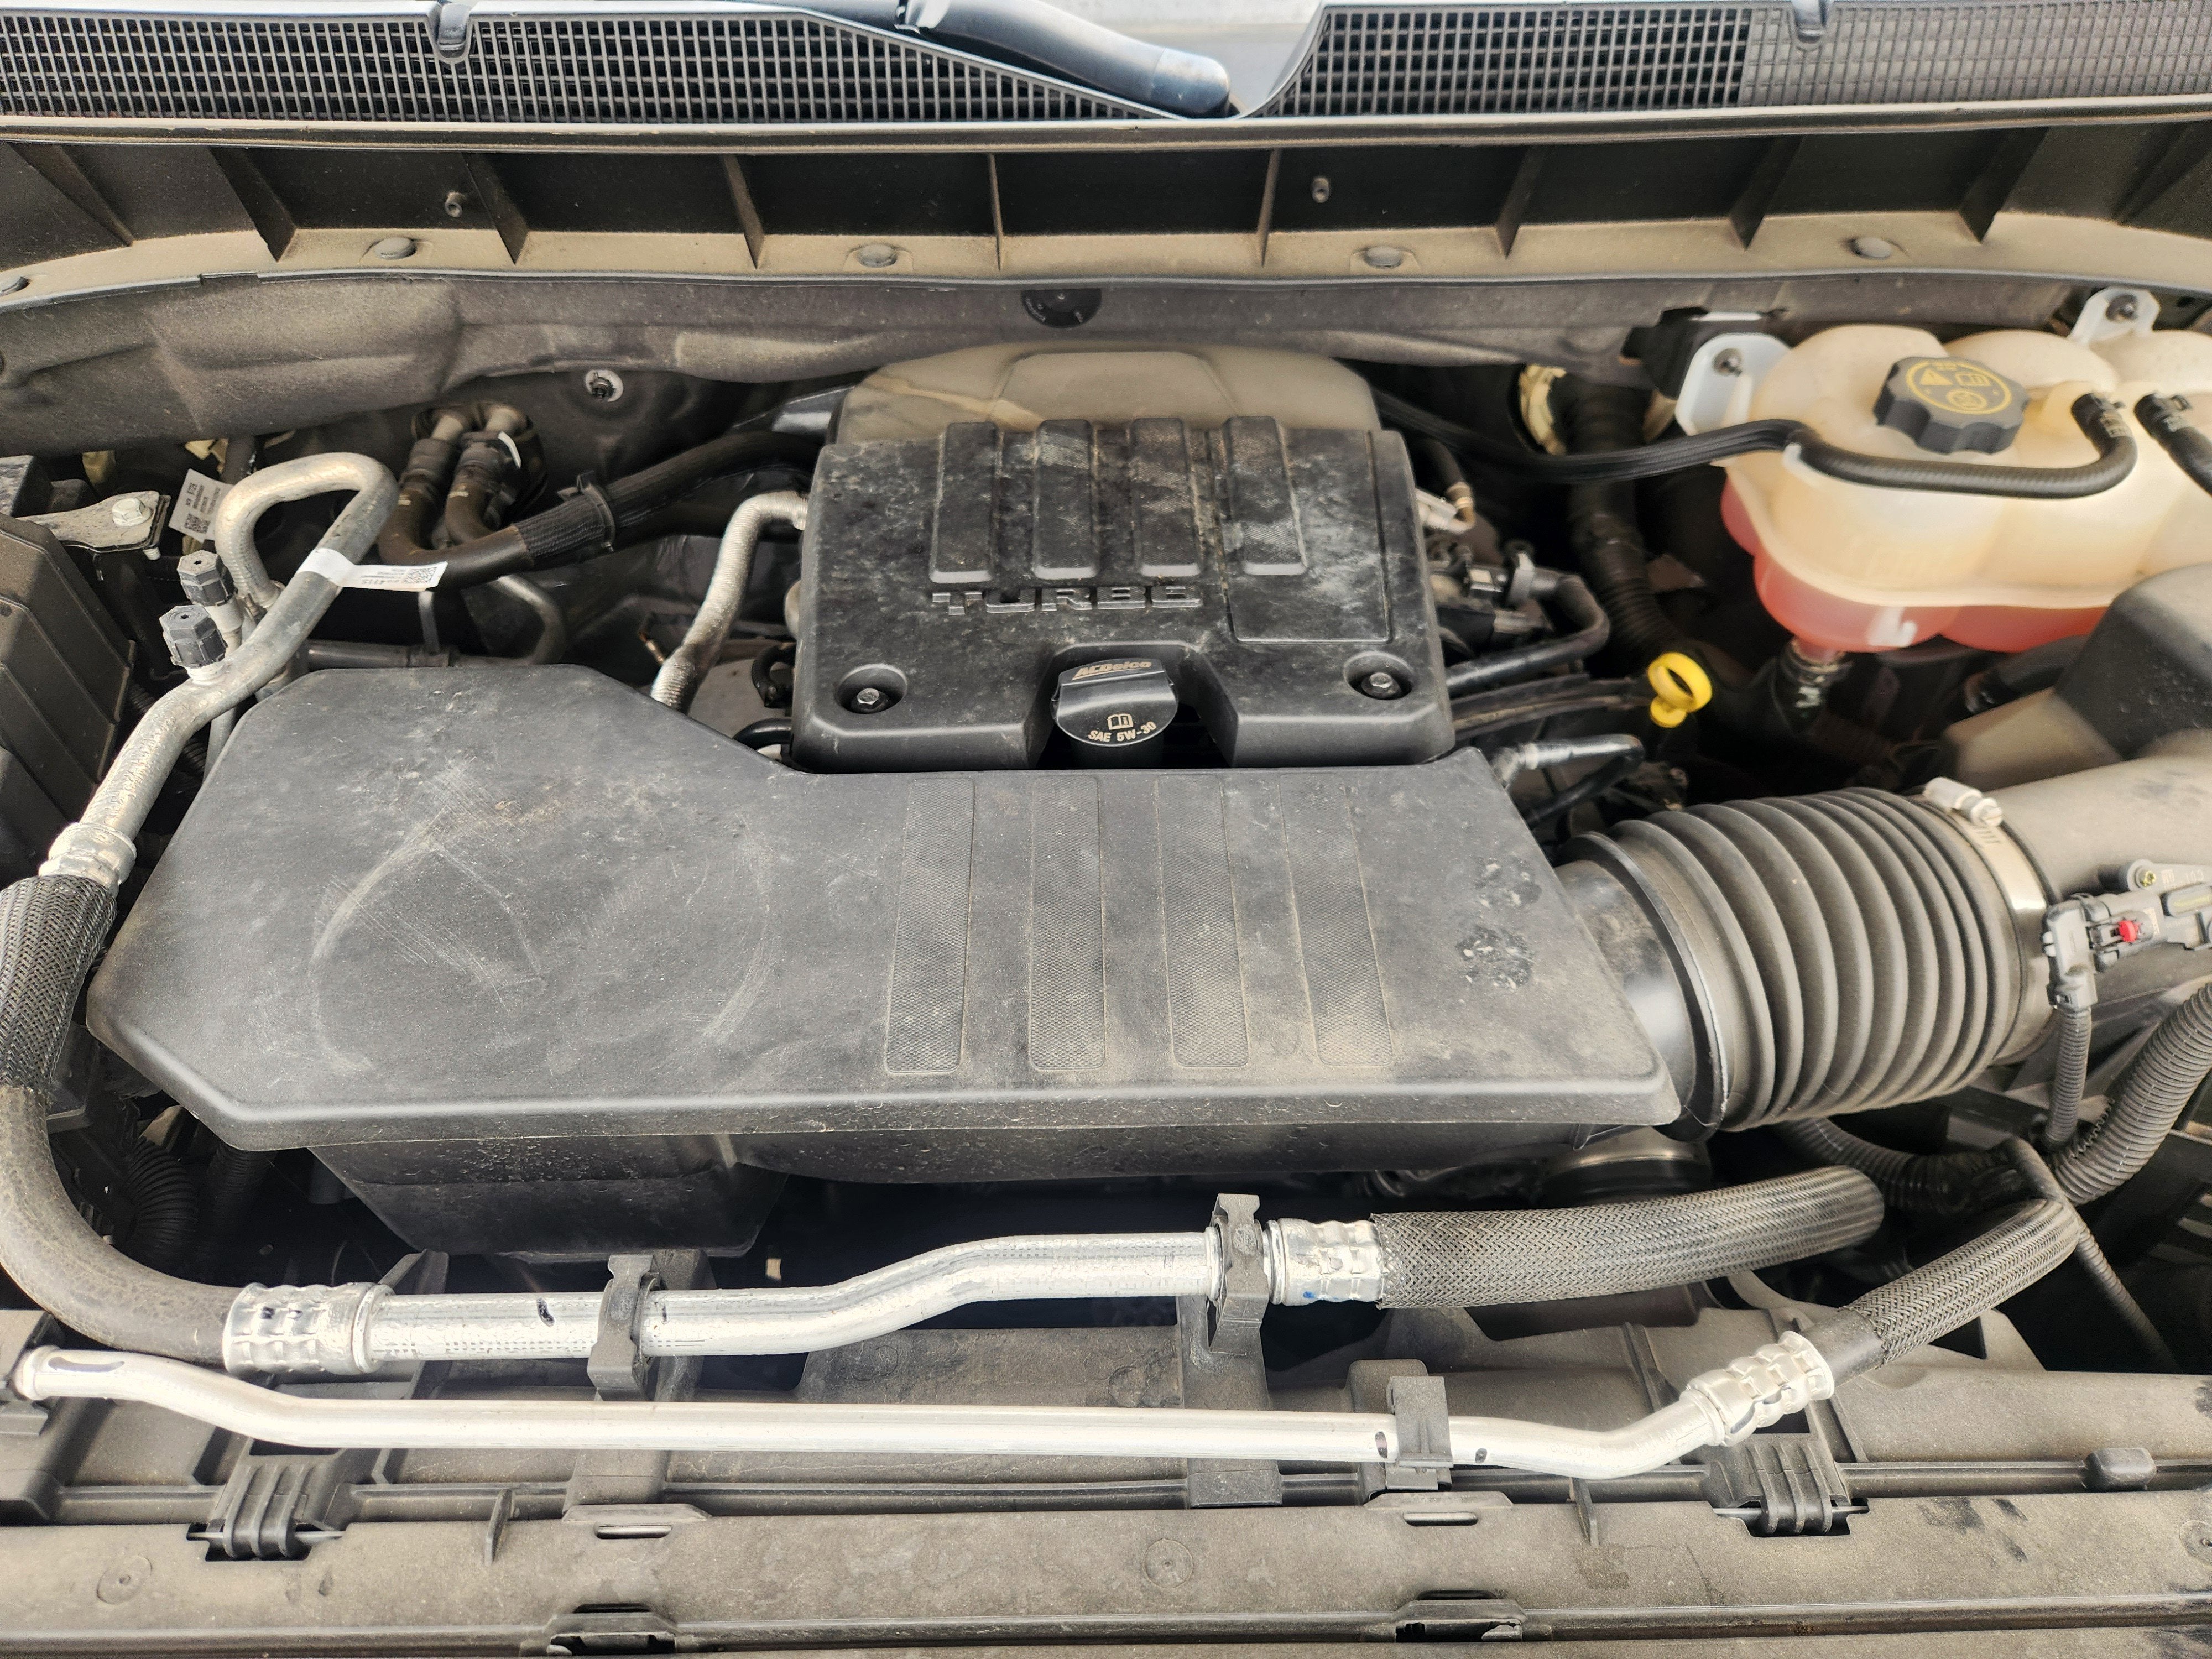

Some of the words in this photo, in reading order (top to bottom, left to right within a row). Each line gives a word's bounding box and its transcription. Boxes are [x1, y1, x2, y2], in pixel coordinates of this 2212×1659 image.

[932, 586, 1203, 615] TURBO
[1072, 661, 1152, 680] ACDelco
[1088, 730, 1112, 742] SAE
[1117, 721, 1156, 742] 5W-30
